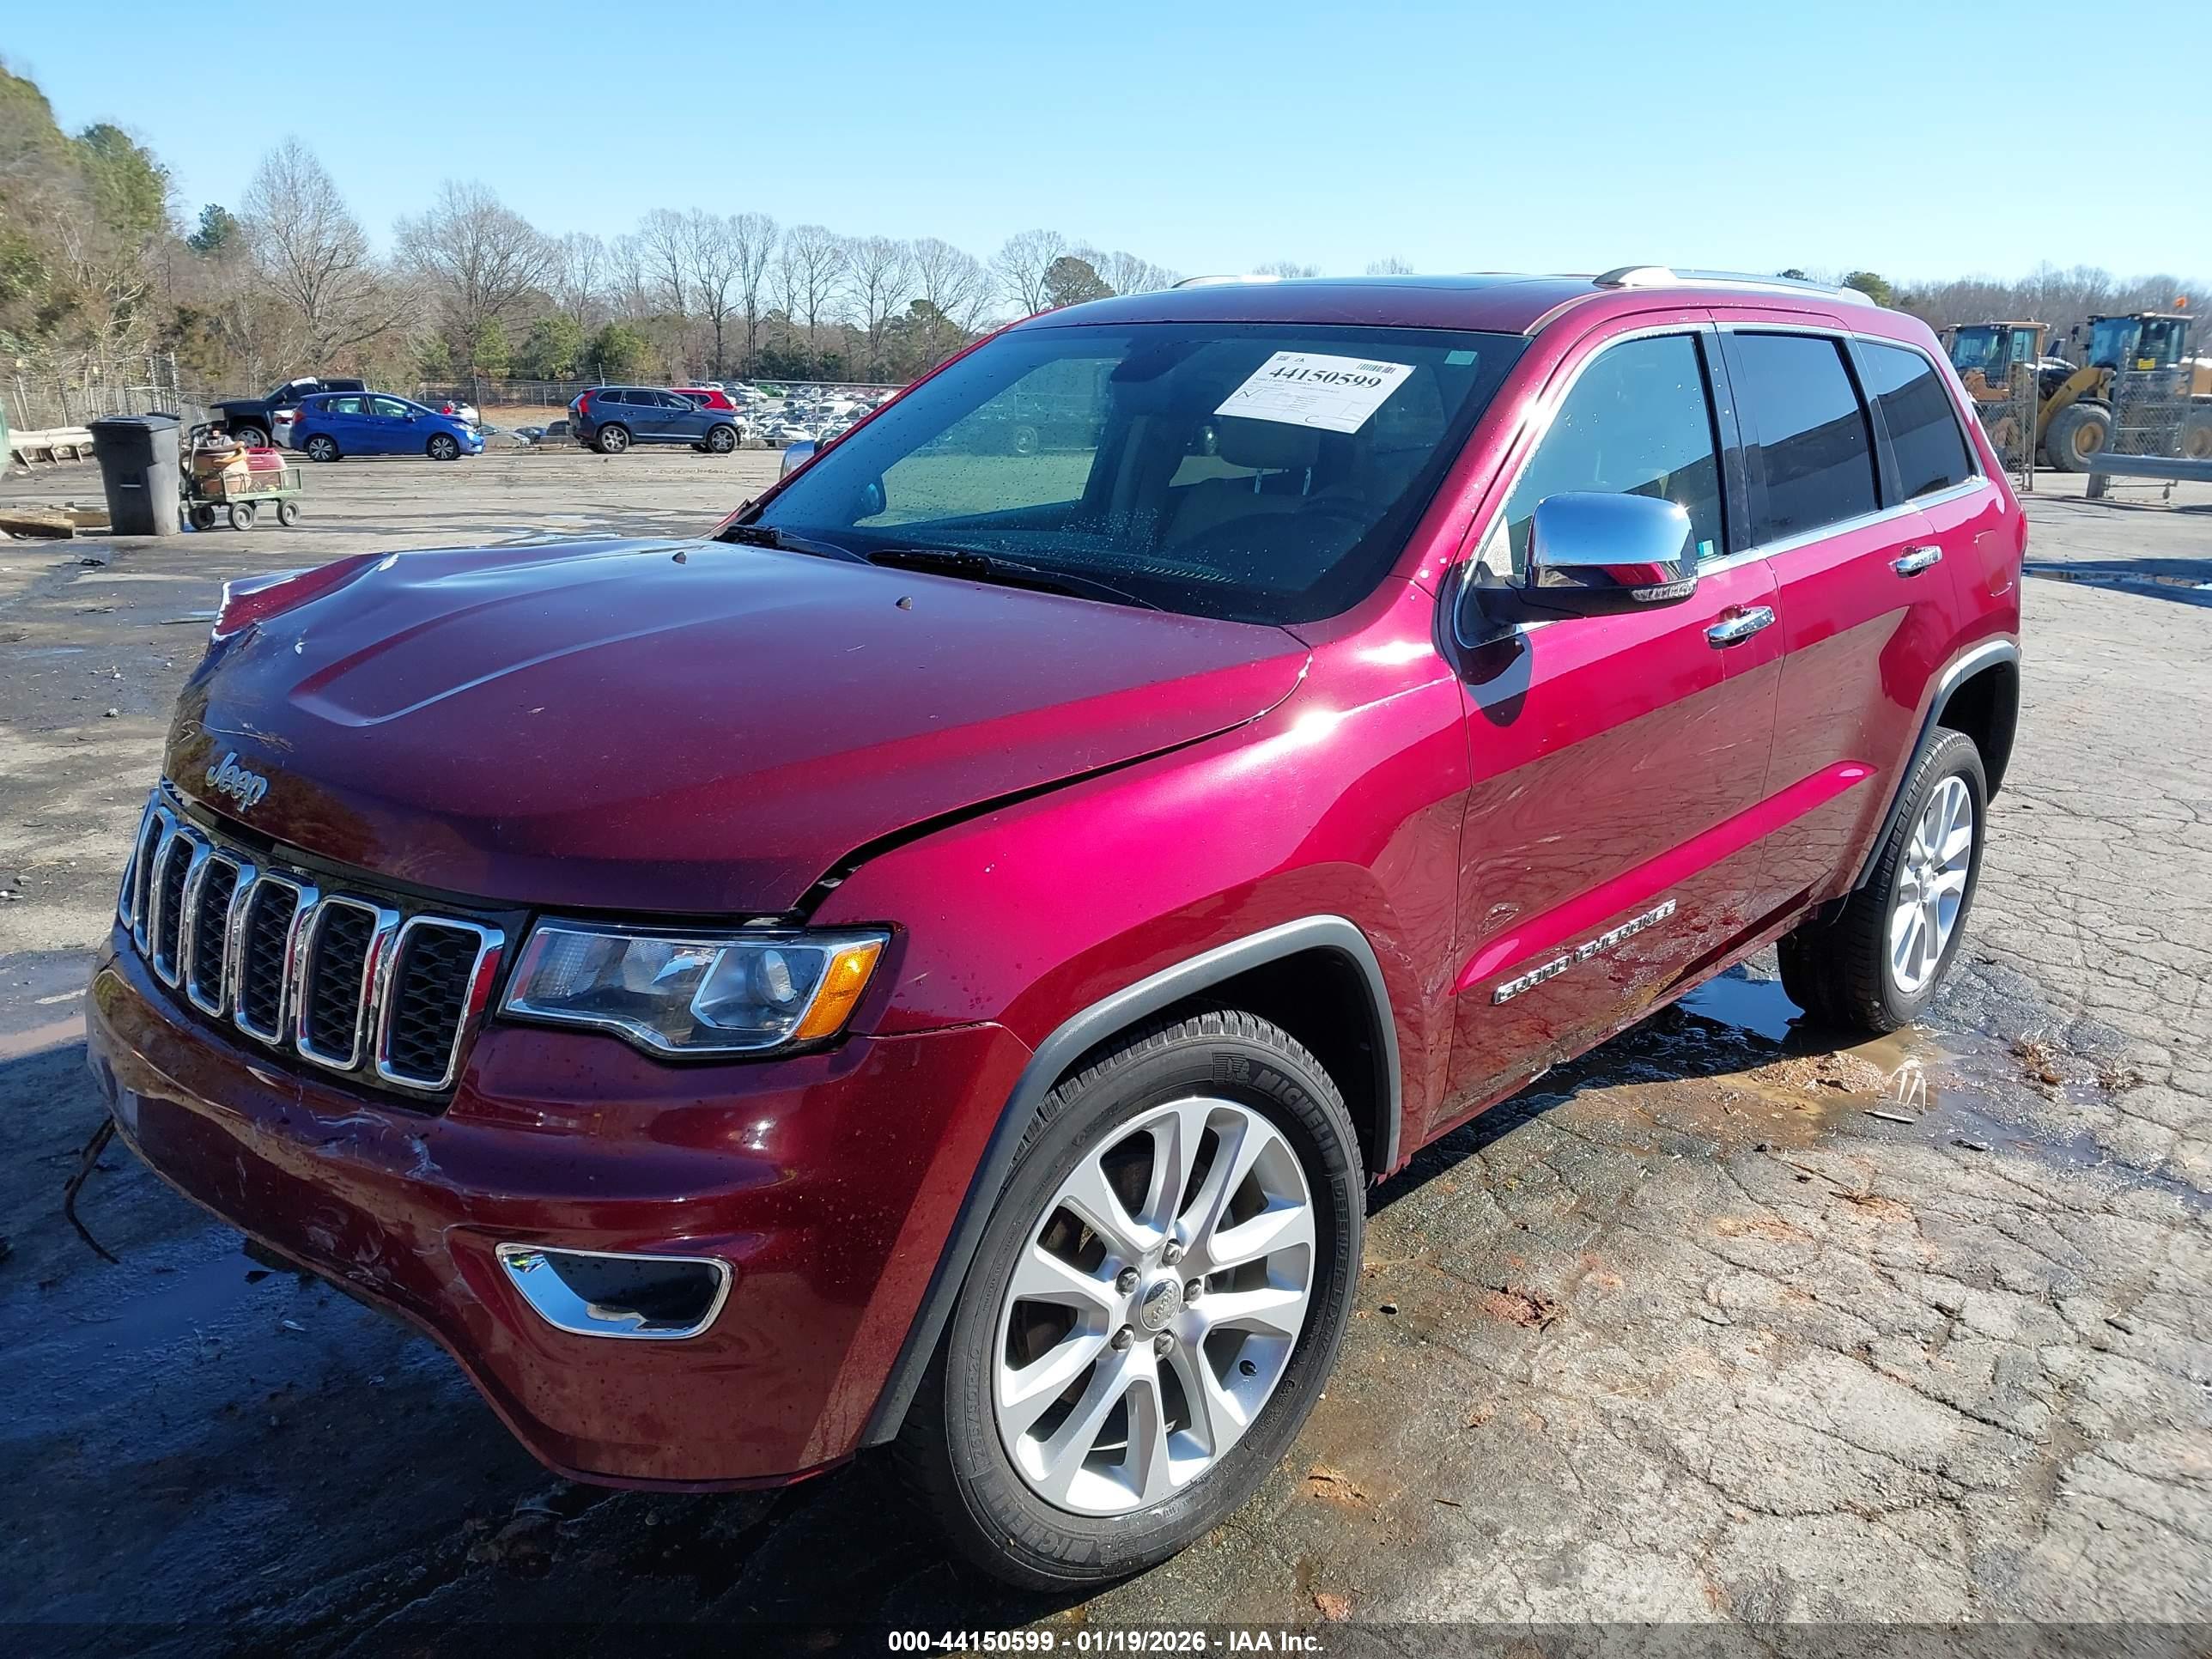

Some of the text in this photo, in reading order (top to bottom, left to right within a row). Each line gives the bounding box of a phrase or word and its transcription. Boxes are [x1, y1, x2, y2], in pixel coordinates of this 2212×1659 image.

[1269, 367, 1382, 388] 44150599
[204, 750, 268, 814] Jeep
[1492, 898, 1677, 1005] GRAND CHEROKEE
[1252, 1069, 1342, 1168] MICHELIN
[980, 1477, 1094, 1564] MICHELIN
